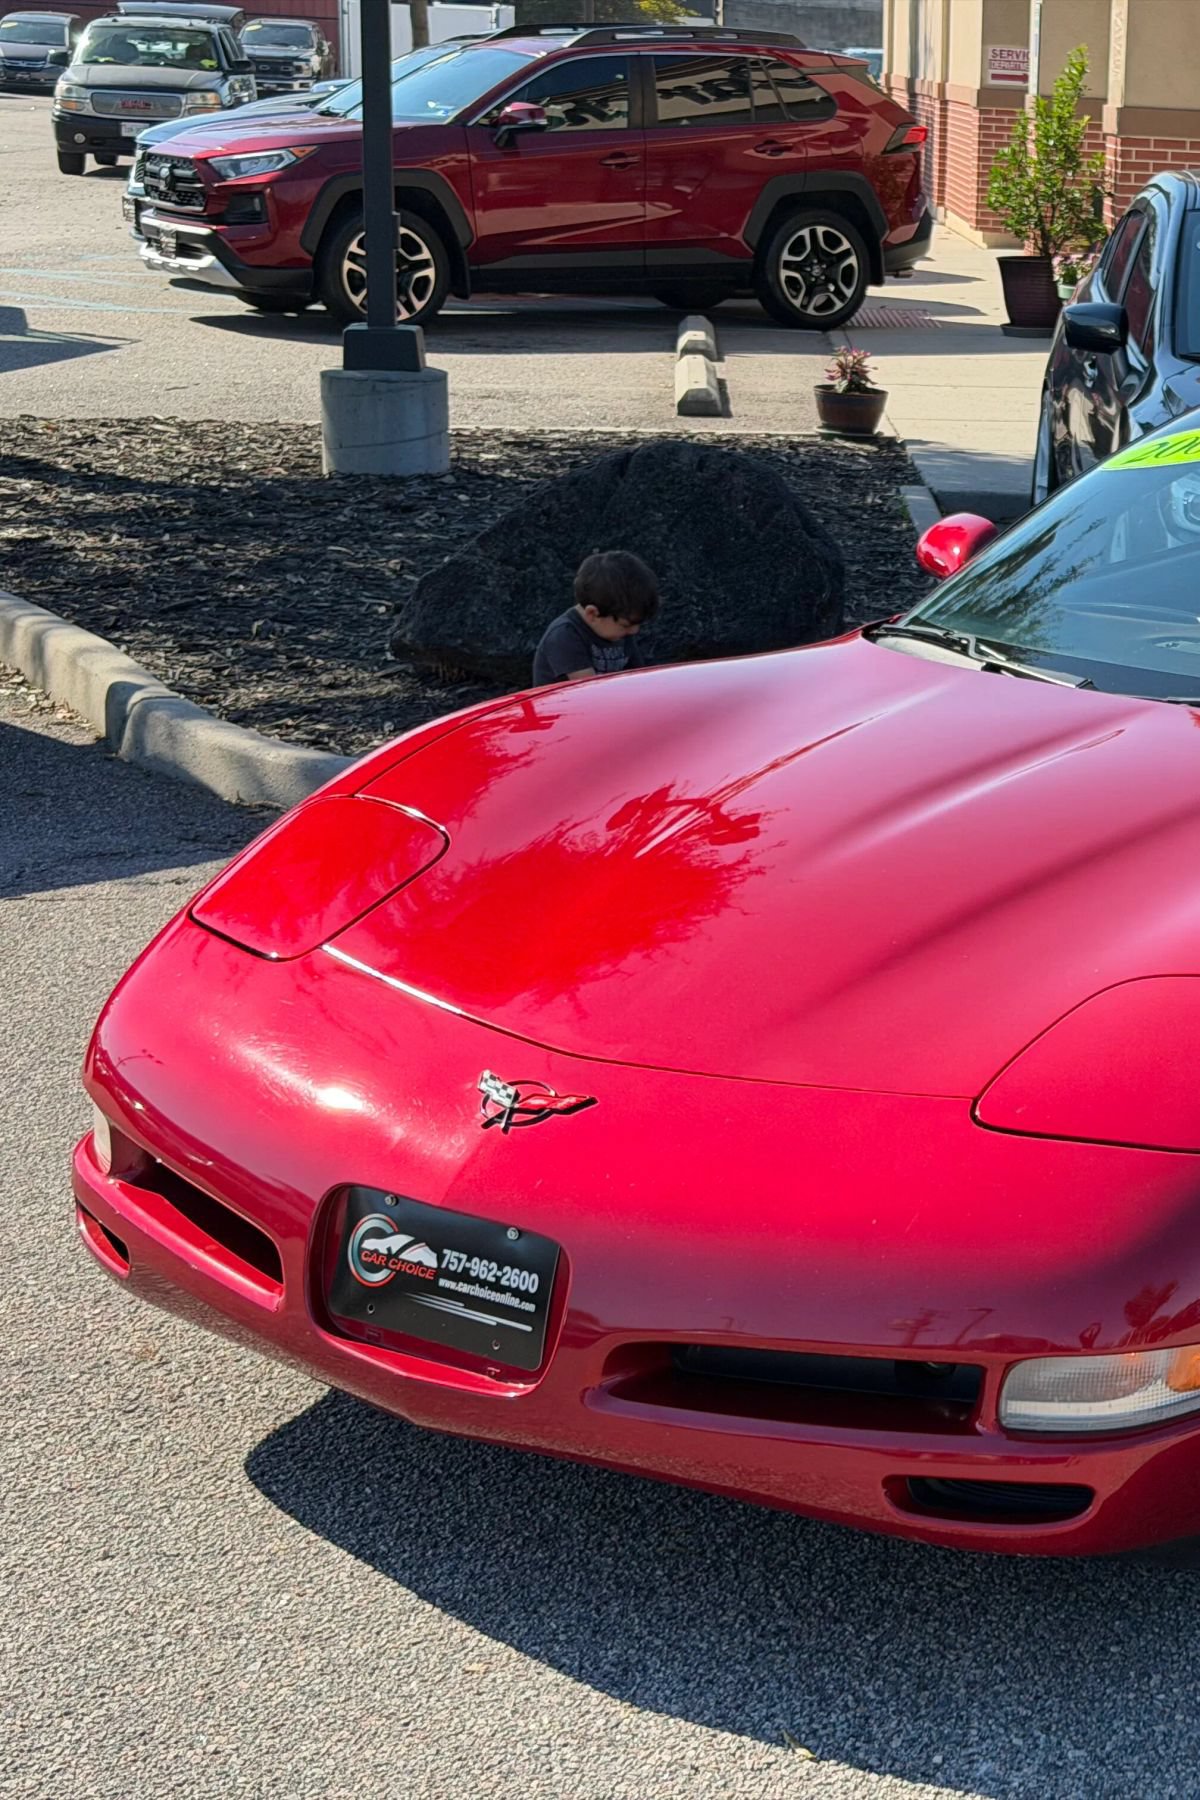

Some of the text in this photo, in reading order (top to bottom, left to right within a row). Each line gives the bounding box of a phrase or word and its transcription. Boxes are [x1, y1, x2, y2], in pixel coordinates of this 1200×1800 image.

[361, 1250, 437, 1281] CAR CHOICE
[440, 1248, 539, 1294] 757-962-2600
[438, 1277, 536, 1313] www.carchoiceonline.com
